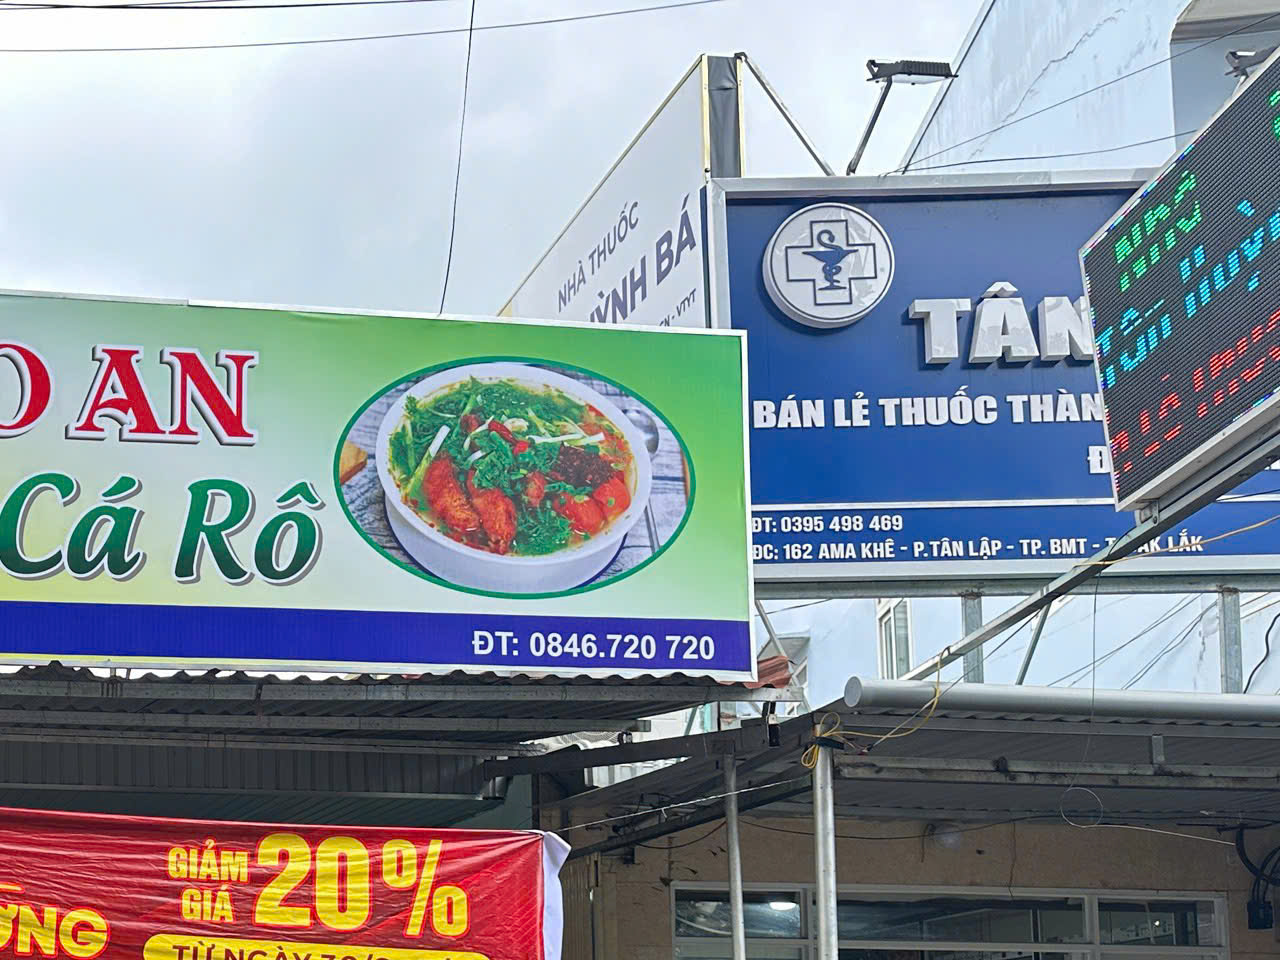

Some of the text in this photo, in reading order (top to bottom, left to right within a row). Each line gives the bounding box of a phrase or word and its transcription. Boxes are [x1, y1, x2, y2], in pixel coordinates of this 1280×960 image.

[558, 201, 639, 313] NHÀ THUỐC
[656, 192, 696, 286] BÁ
[908, 281, 1095, 363] TÂN
[65, 343, 260, 446] AN
[753, 393, 825, 429] BÁN
[833, 391, 870, 427] LẺ
[878, 385, 997, 427] THUỐC
[174, 477, 326, 586] Rô
[751, 515, 903, 533] ĐT: 0395 498 469
[751, 544, 779, 560] ĐC:
[783, 544, 813, 560] 162
[818, 544, 856, 559] AMA
[861, 538, 895, 559] KHÊ
[968, 537, 1002, 560] LẬP
[1019, 540, 1046, 555] TP.
[1049, 539, 1087, 555] BMT
[1168, 529, 1203, 552] LẮK
[471, 631, 715, 661] ĐT: 0846.720 720
[167, 831, 469, 938] GIẢM 20%
[180, 884, 235, 924] GIÁ
